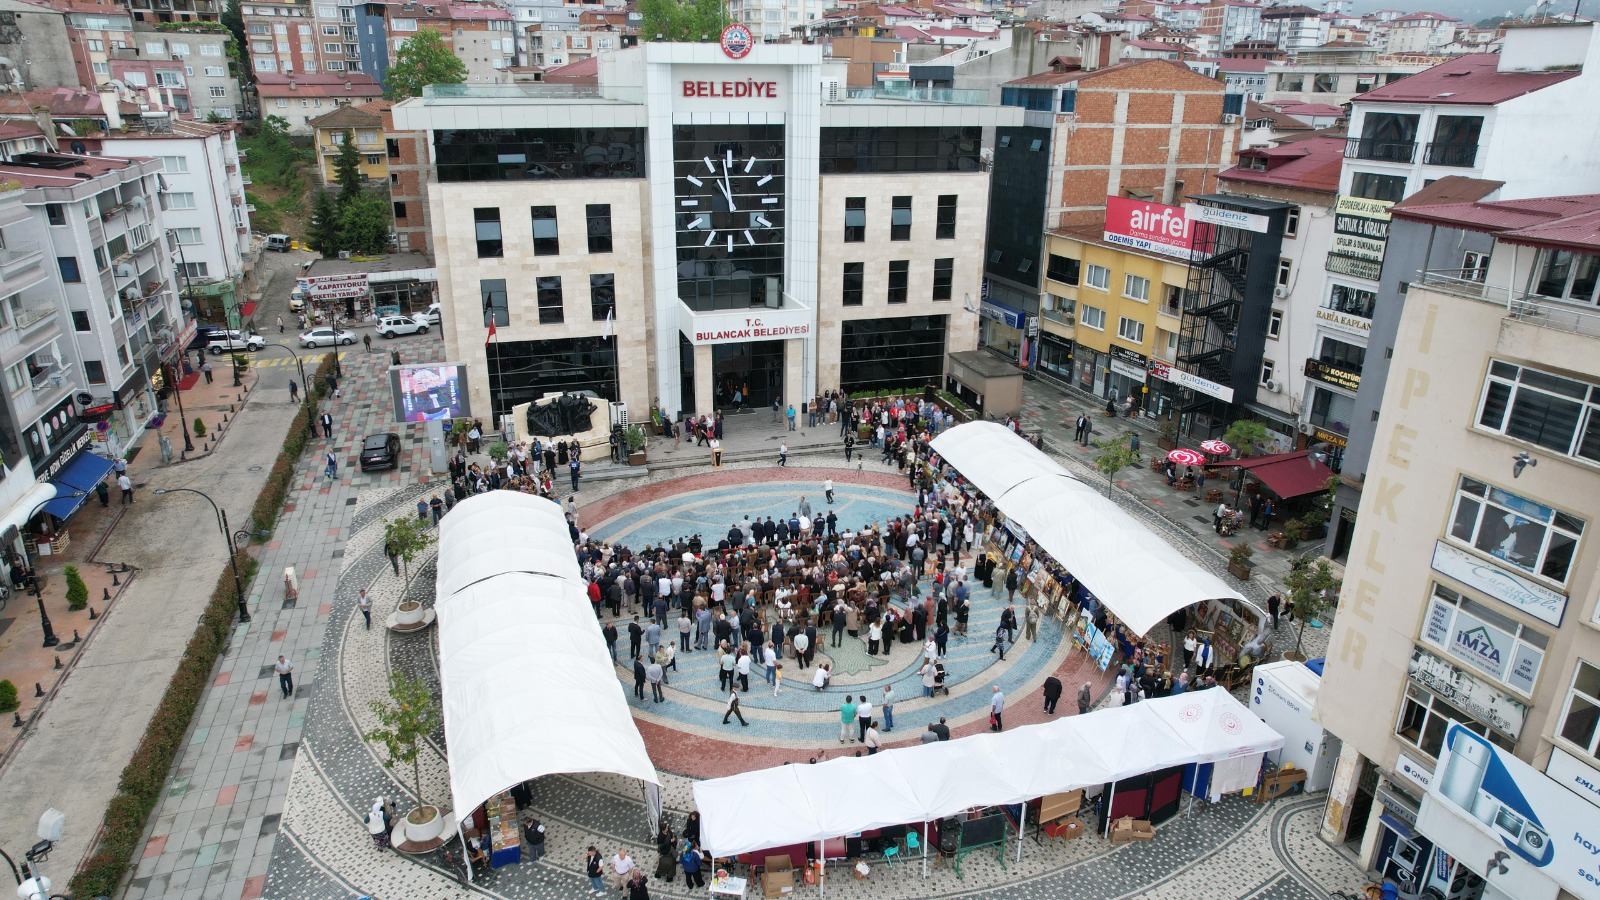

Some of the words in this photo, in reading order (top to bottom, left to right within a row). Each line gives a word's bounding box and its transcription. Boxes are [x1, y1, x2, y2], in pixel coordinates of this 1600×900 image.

[682, 77, 777, 98] BELEDİYE
[1130, 205, 1190, 239] airfel
[1203, 207, 1248, 222] güldeniz
[1135, 240, 1151, 249] YAPI
[317, 281, 367, 290] KAPATIYORUZ
[1316, 310, 1339, 323] RABİA
[696, 329, 751, 341] BULANCAK
[753, 323, 810, 337] BELEDİYESİ
[1180, 373, 1220, 391] güldeniz
[449, 380, 457, 405] MOBİLYA
[60, 443, 78, 465] GÜZELLİK
[1456, 630, 1500, 664] İMZA
[1411, 770, 1429, 785] QNB
